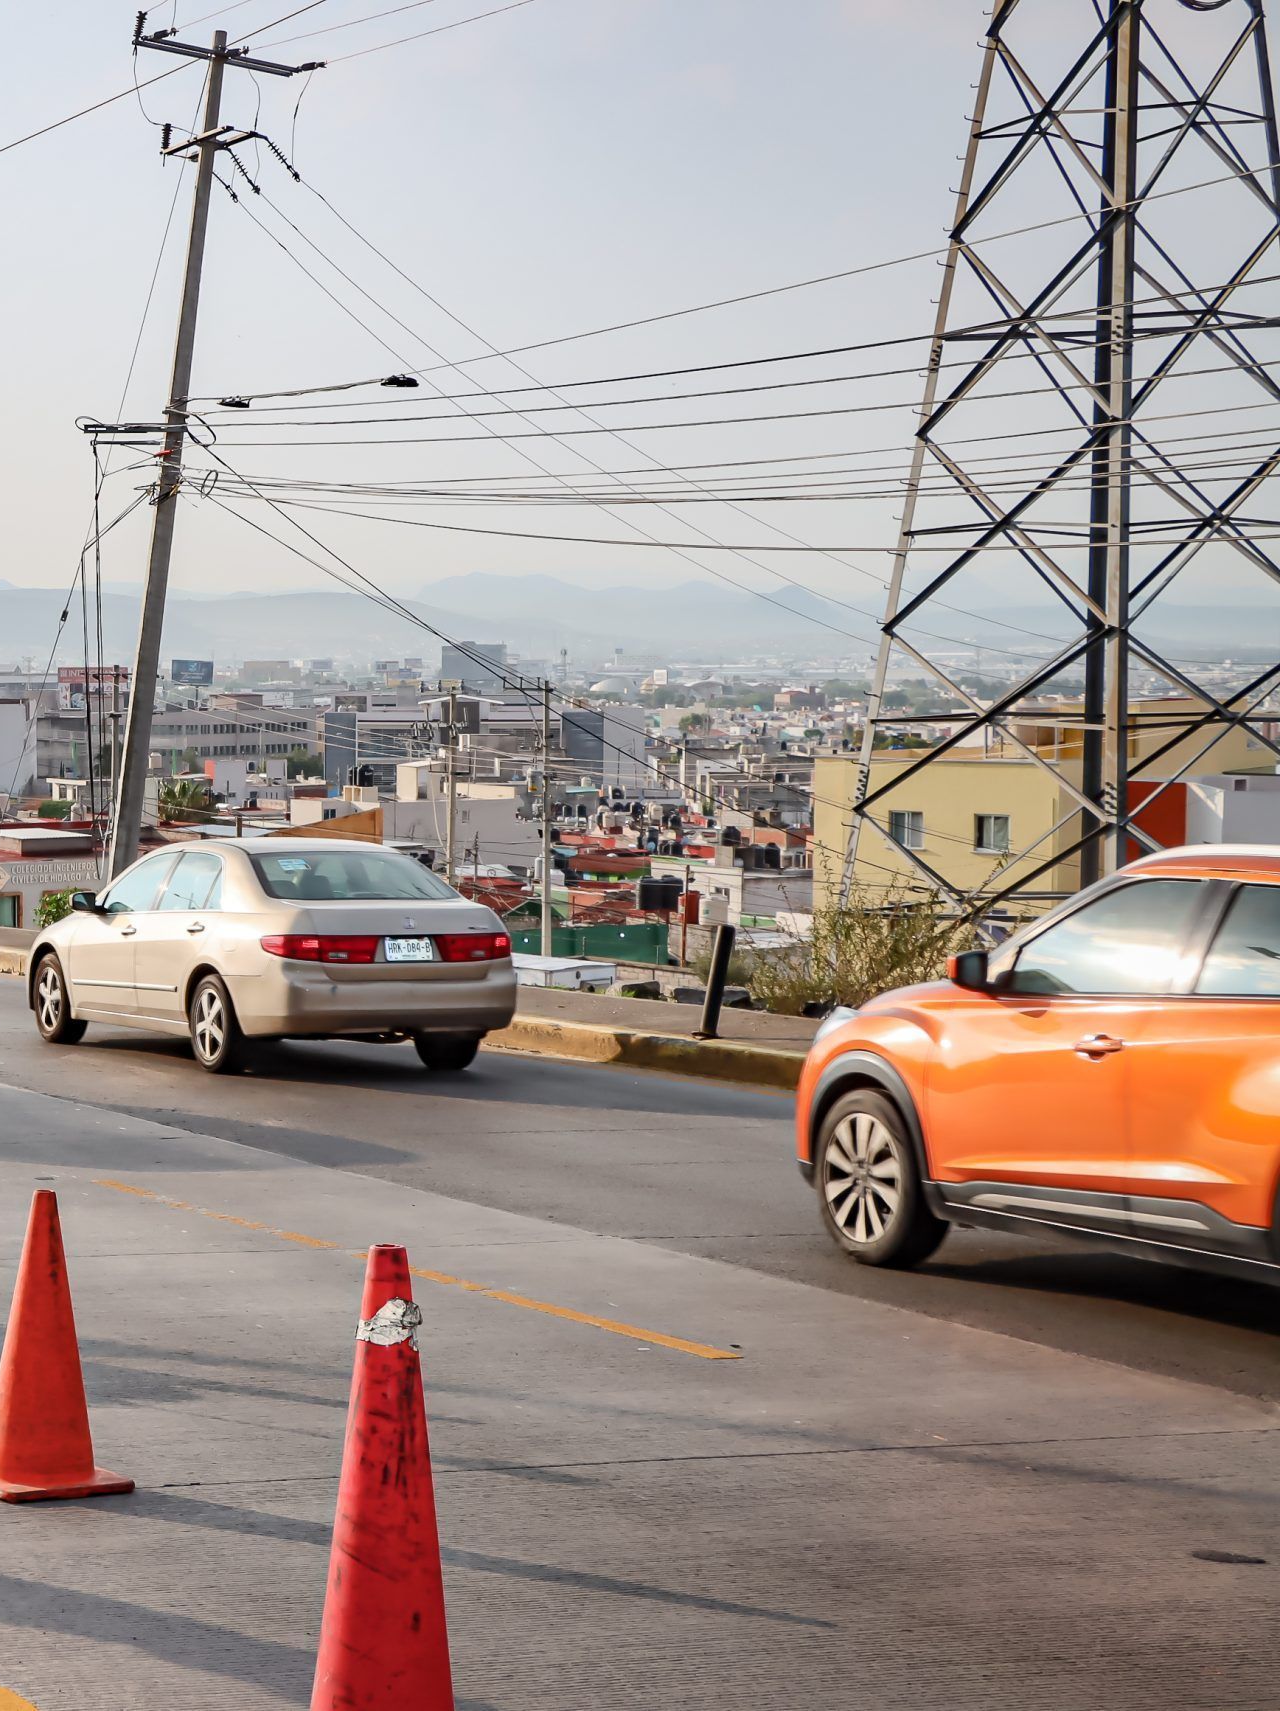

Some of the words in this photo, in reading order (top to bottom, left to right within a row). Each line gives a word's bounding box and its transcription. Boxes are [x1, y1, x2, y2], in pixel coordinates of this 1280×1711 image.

[11, 863, 44, 874] COLEGIO
[44, 863, 53, 873] DE
[53, 861, 96, 873] INGENIEROS
[11, 874, 38, 884] CIVILES
[39, 873, 49, 883] DE
[50, 872, 81, 882] HIDALGO
